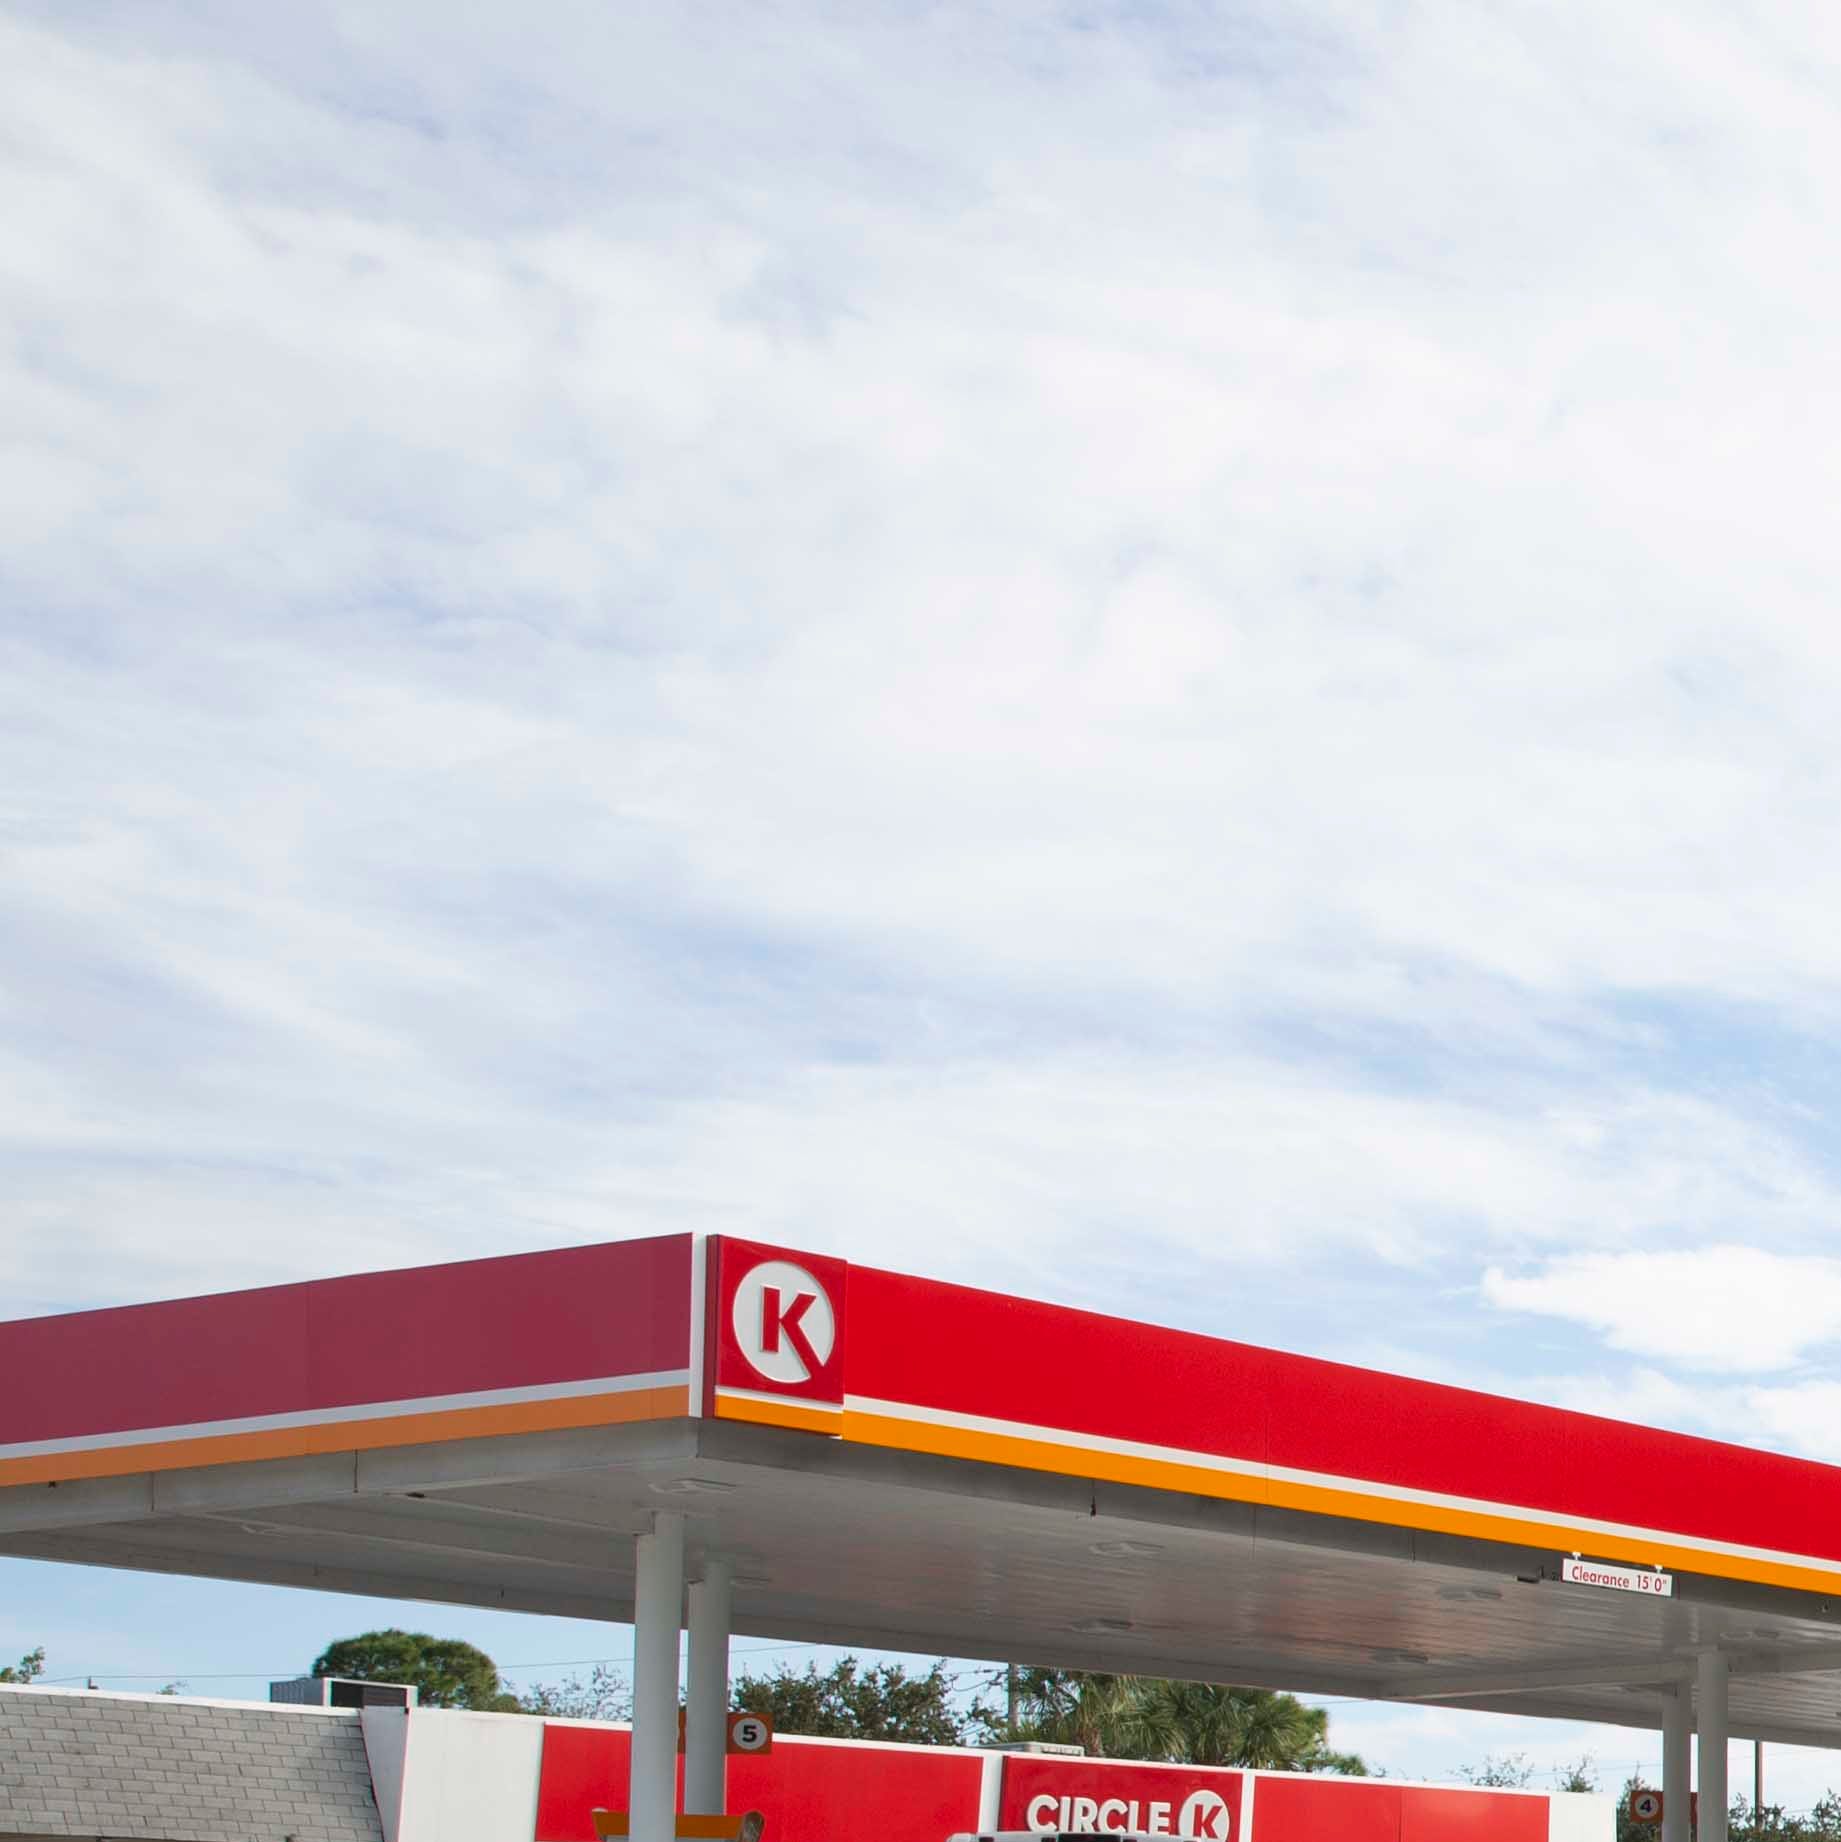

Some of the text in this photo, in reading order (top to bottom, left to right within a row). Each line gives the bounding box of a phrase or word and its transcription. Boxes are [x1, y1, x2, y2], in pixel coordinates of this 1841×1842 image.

[762, 1285, 824, 1378] K
[1571, 1565, 1630, 1588] Clearance
[742, 1724, 757, 1743] 5
[1026, 1794, 1172, 1835] CIRCLE
[1640, 1799, 1652, 1813] 4
